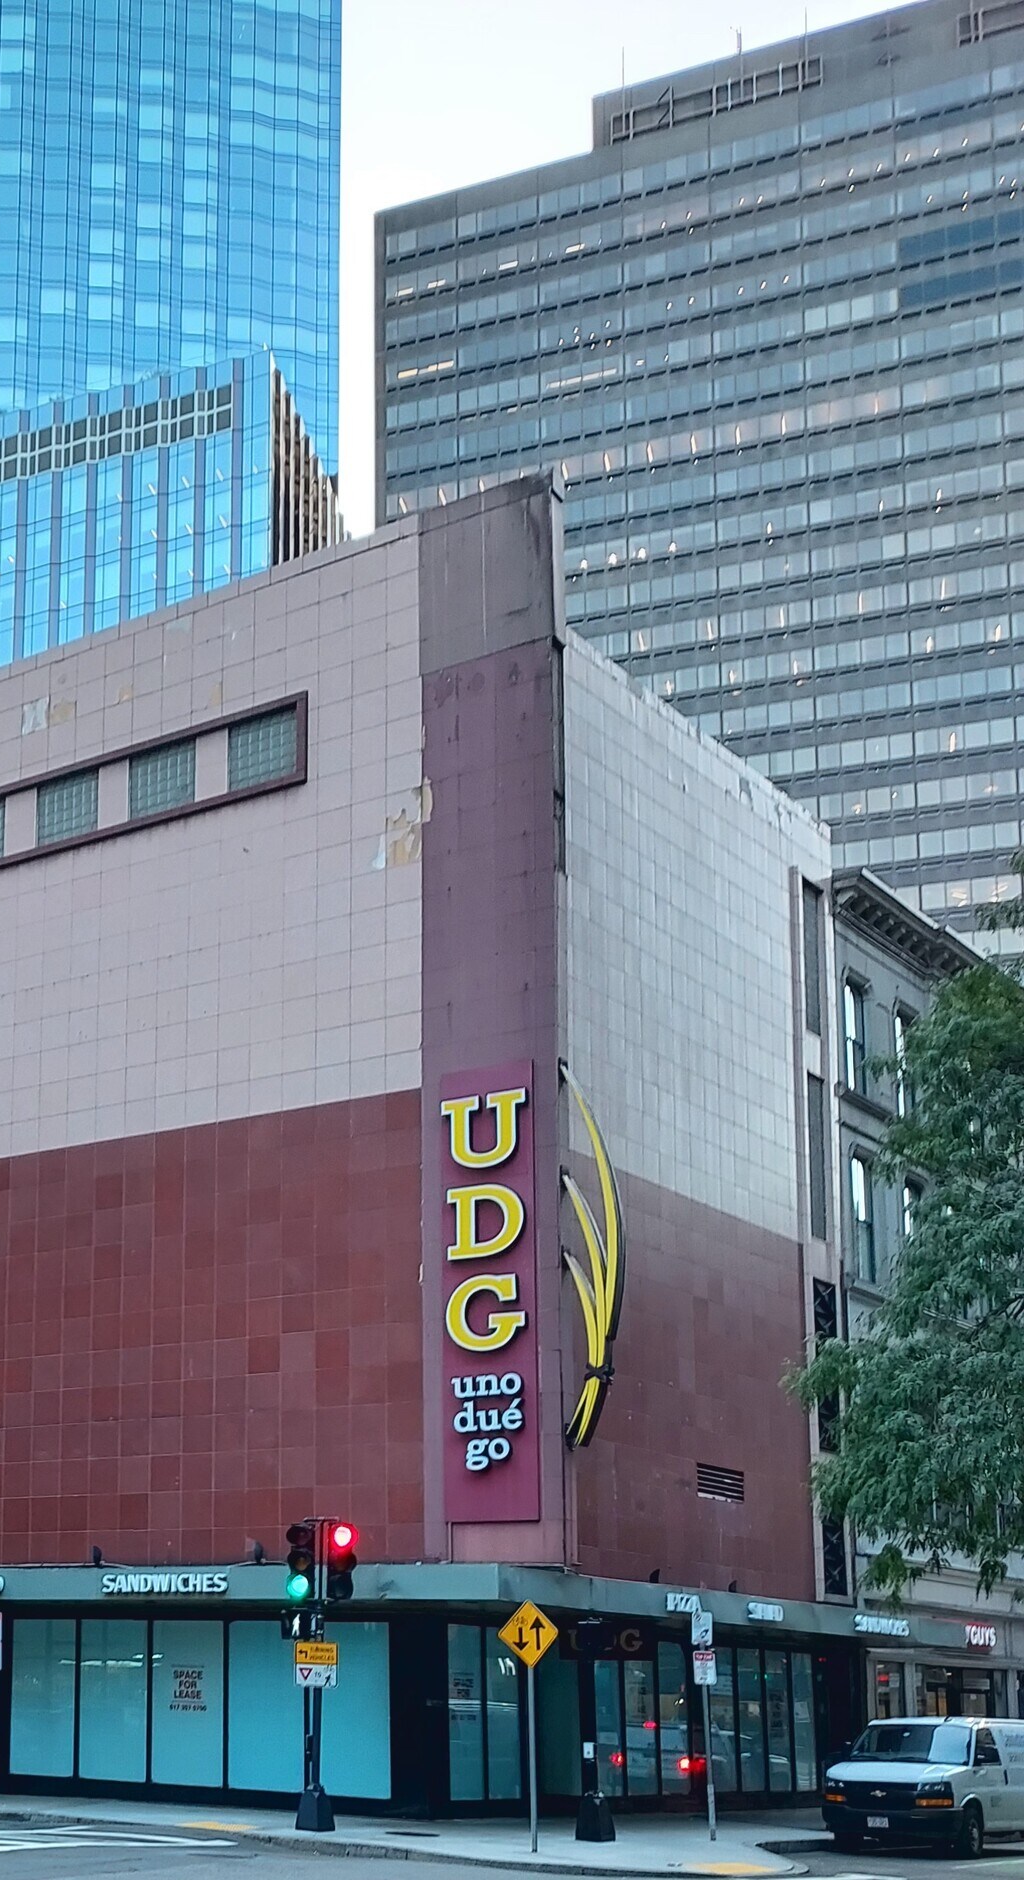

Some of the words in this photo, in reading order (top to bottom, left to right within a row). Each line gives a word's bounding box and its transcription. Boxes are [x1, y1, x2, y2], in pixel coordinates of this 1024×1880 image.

[451, 1372, 523, 1400] uno
[452, 1397, 523, 1434] dué
[465, 1436, 511, 1472] go
[101, 1573, 228, 1593] SANDWICHES
[970, 1625, 997, 1648] GUYS
[173, 1669, 204, 1680] SPACE
[178, 1679, 198, 1690] FOR
[173, 1689, 202, 1700] LEASE
